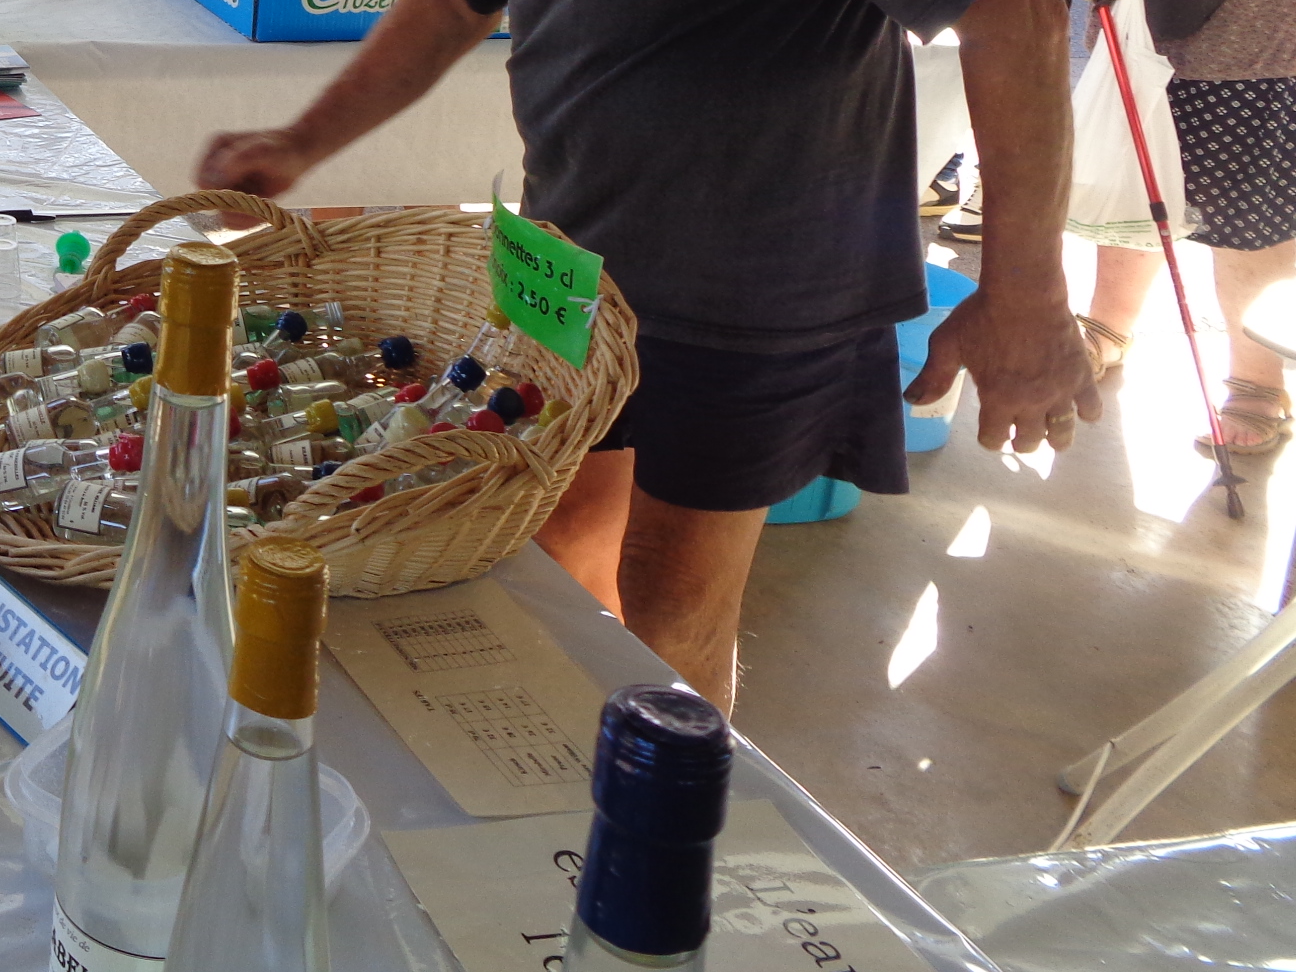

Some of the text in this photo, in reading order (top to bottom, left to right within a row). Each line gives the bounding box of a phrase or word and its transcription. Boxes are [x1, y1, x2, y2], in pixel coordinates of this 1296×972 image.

[544, 259, 555, 279] 3
[560, 268, 574, 290] cl
[555, 306, 567, 326] €
[745, 878, 857, 972] L'ea
[79, 940, 90, 953] de
